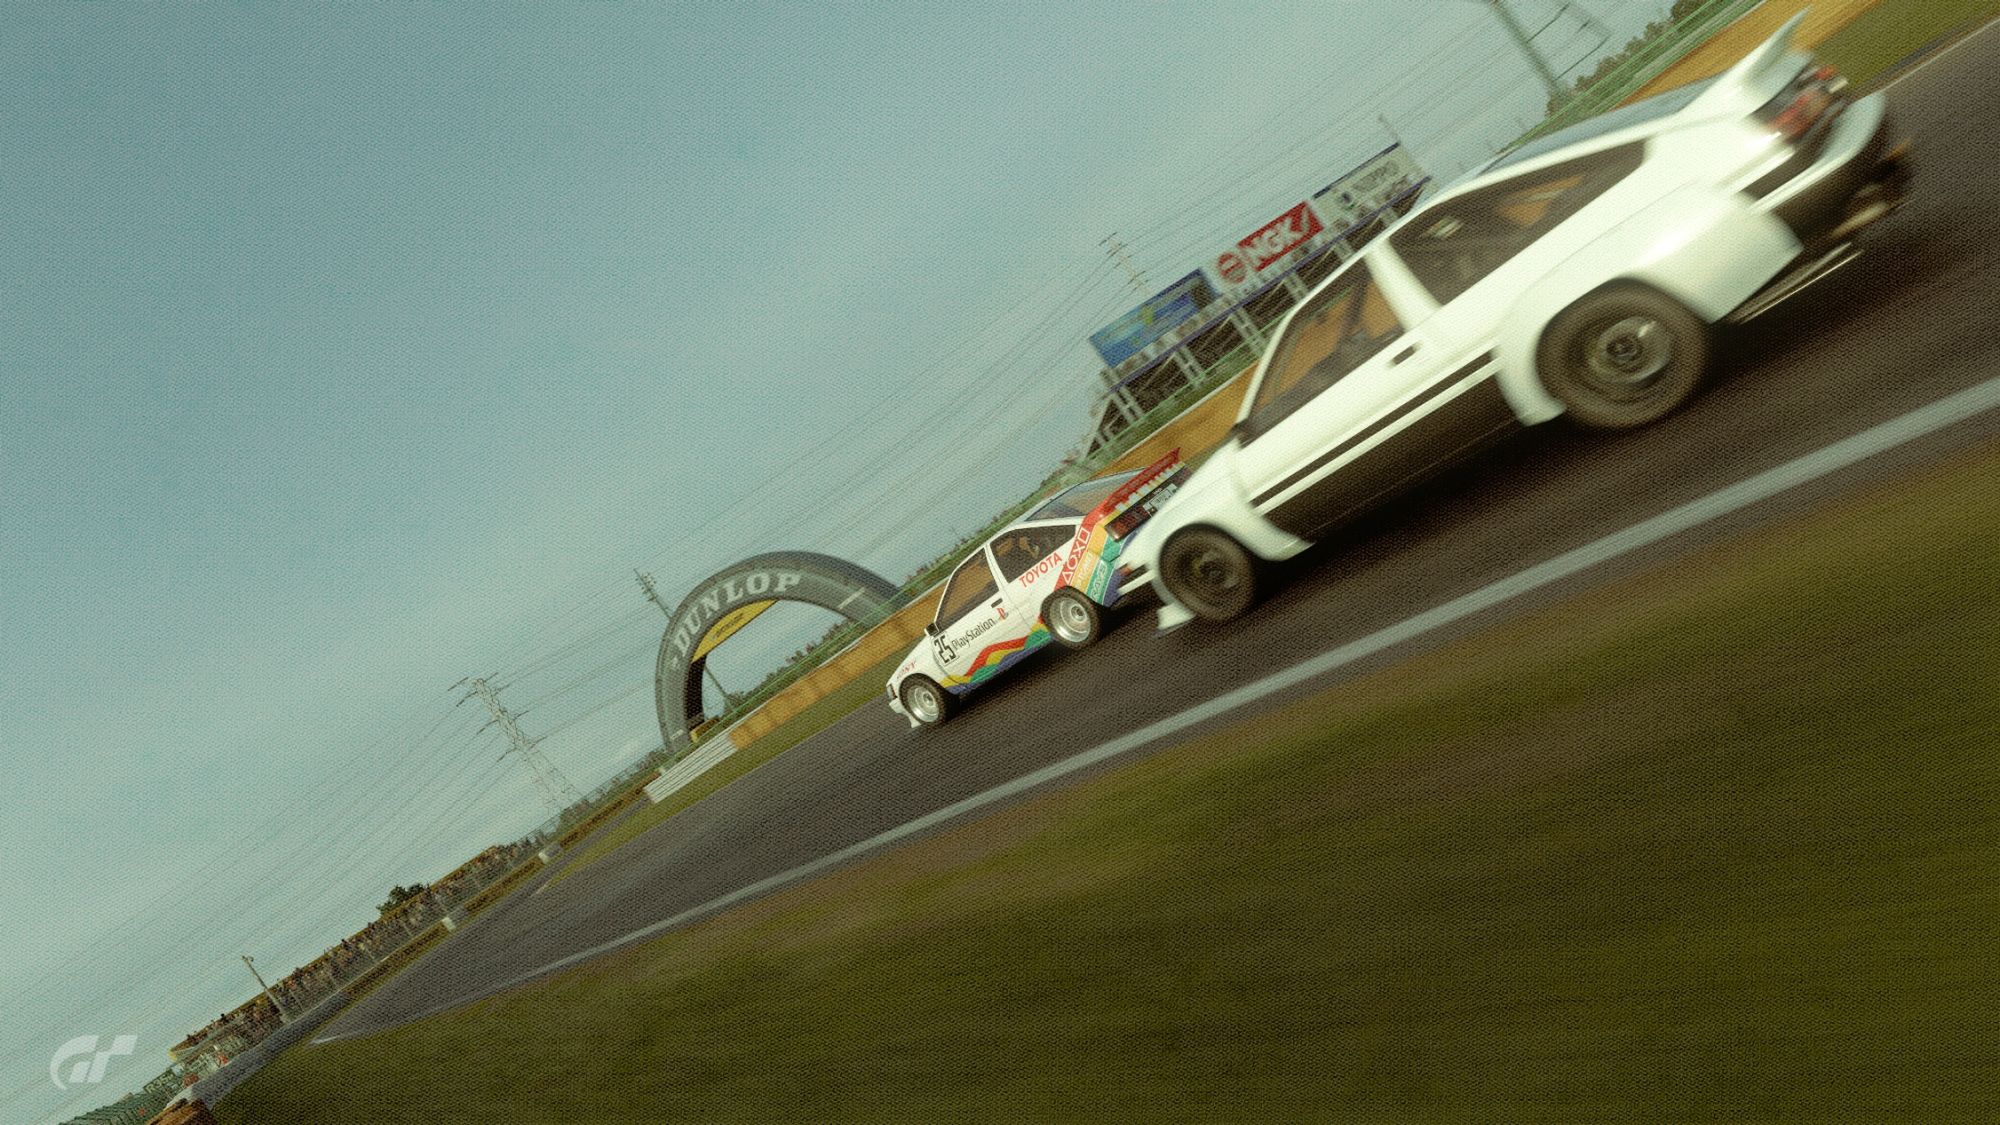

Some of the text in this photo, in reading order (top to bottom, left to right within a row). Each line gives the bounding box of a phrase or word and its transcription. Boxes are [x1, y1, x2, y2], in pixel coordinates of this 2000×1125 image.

[1244, 213, 1302, 264] NGK
[1019, 551, 1063, 588] TOYOTA
[673, 572, 802, 655] DUNLOP
[933, 634, 956, 664] 25
[952, 617, 996, 651] PlayStation
